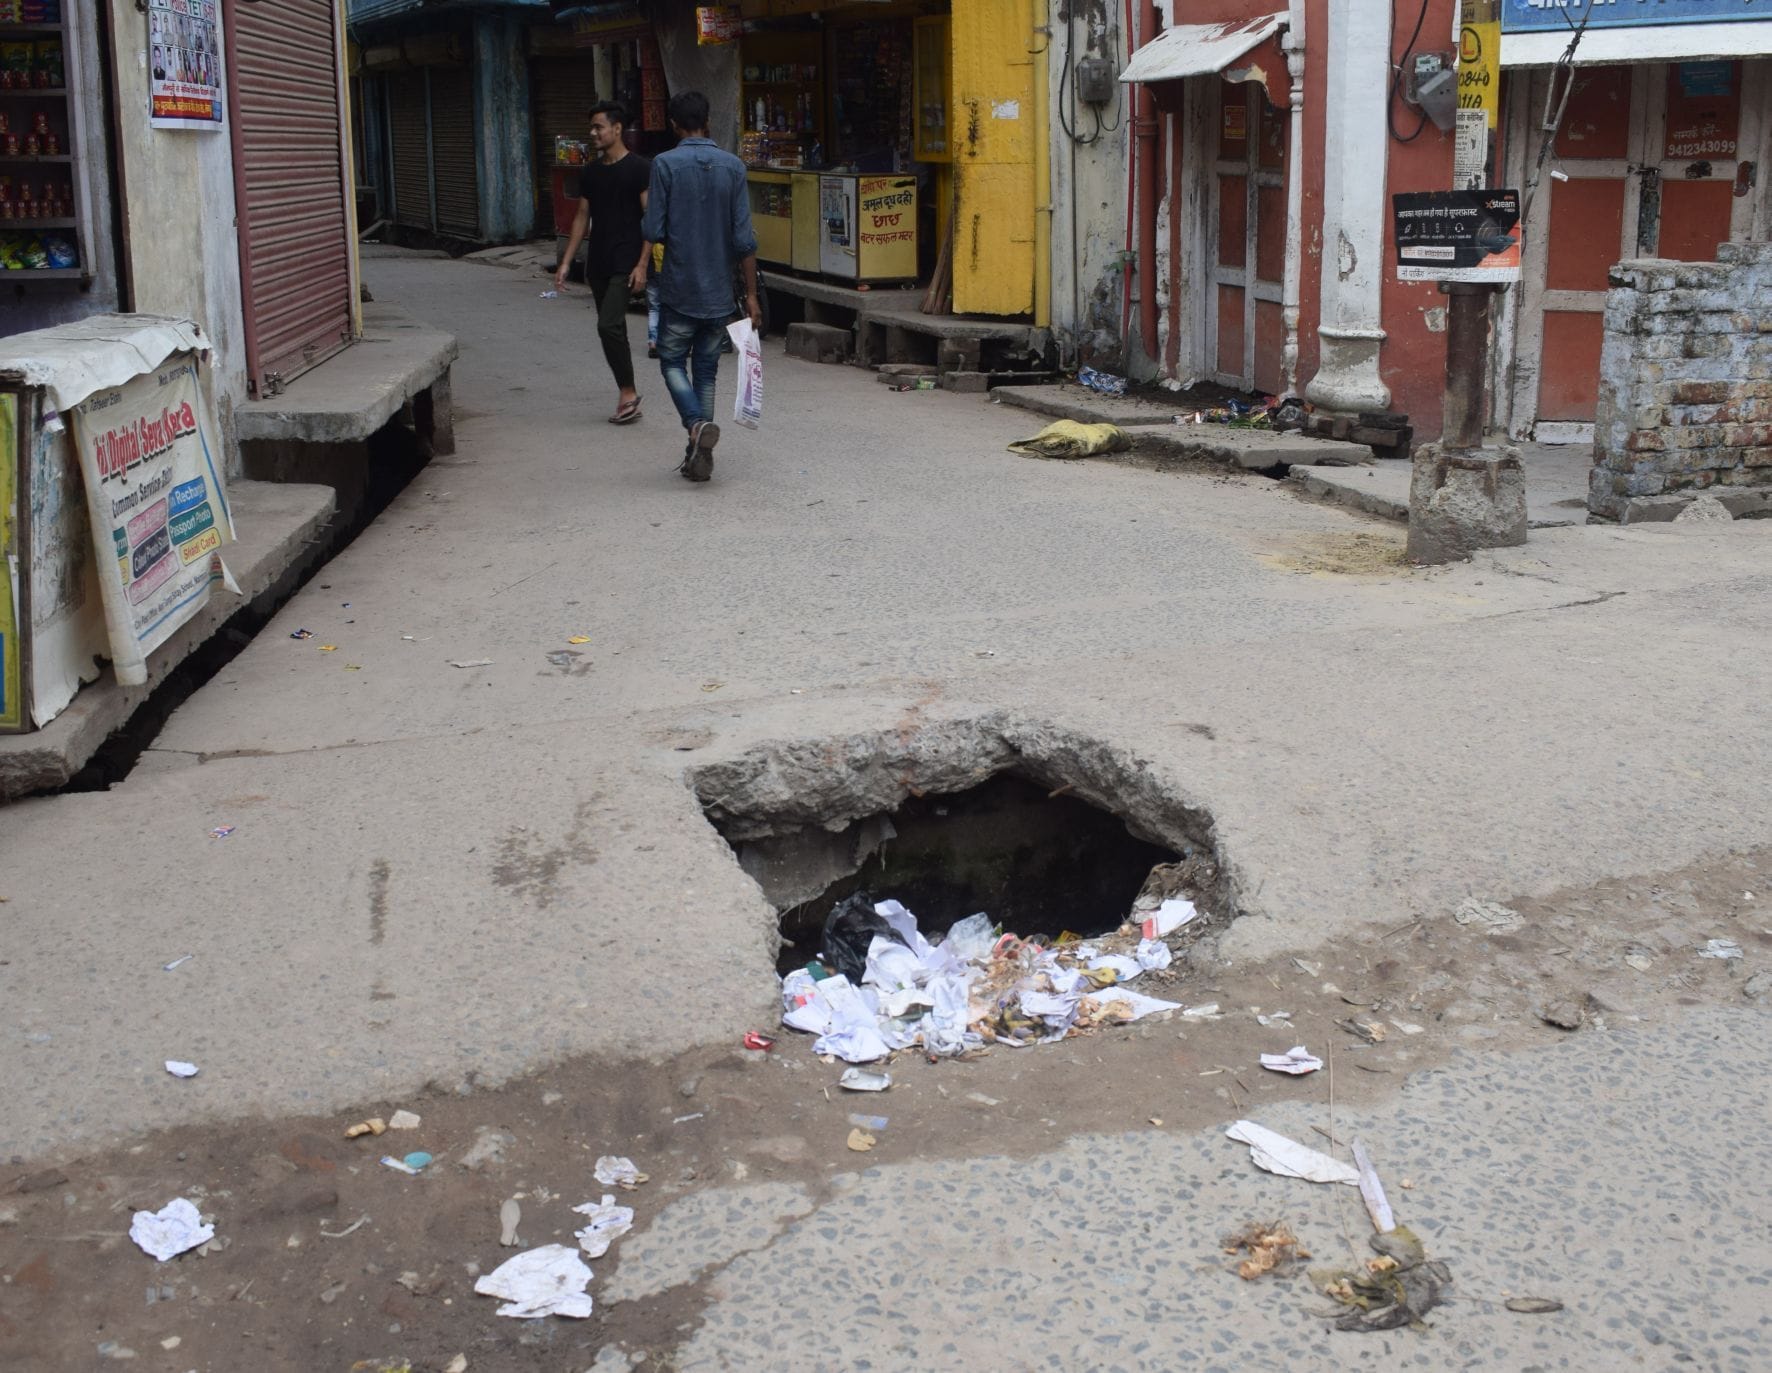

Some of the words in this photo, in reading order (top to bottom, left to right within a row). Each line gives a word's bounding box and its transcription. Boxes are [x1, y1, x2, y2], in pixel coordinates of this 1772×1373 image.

[1668, 140, 1736, 156] 9412343099
[872, 213, 903, 228] छाछ
[107, 420, 140, 477] Digital
